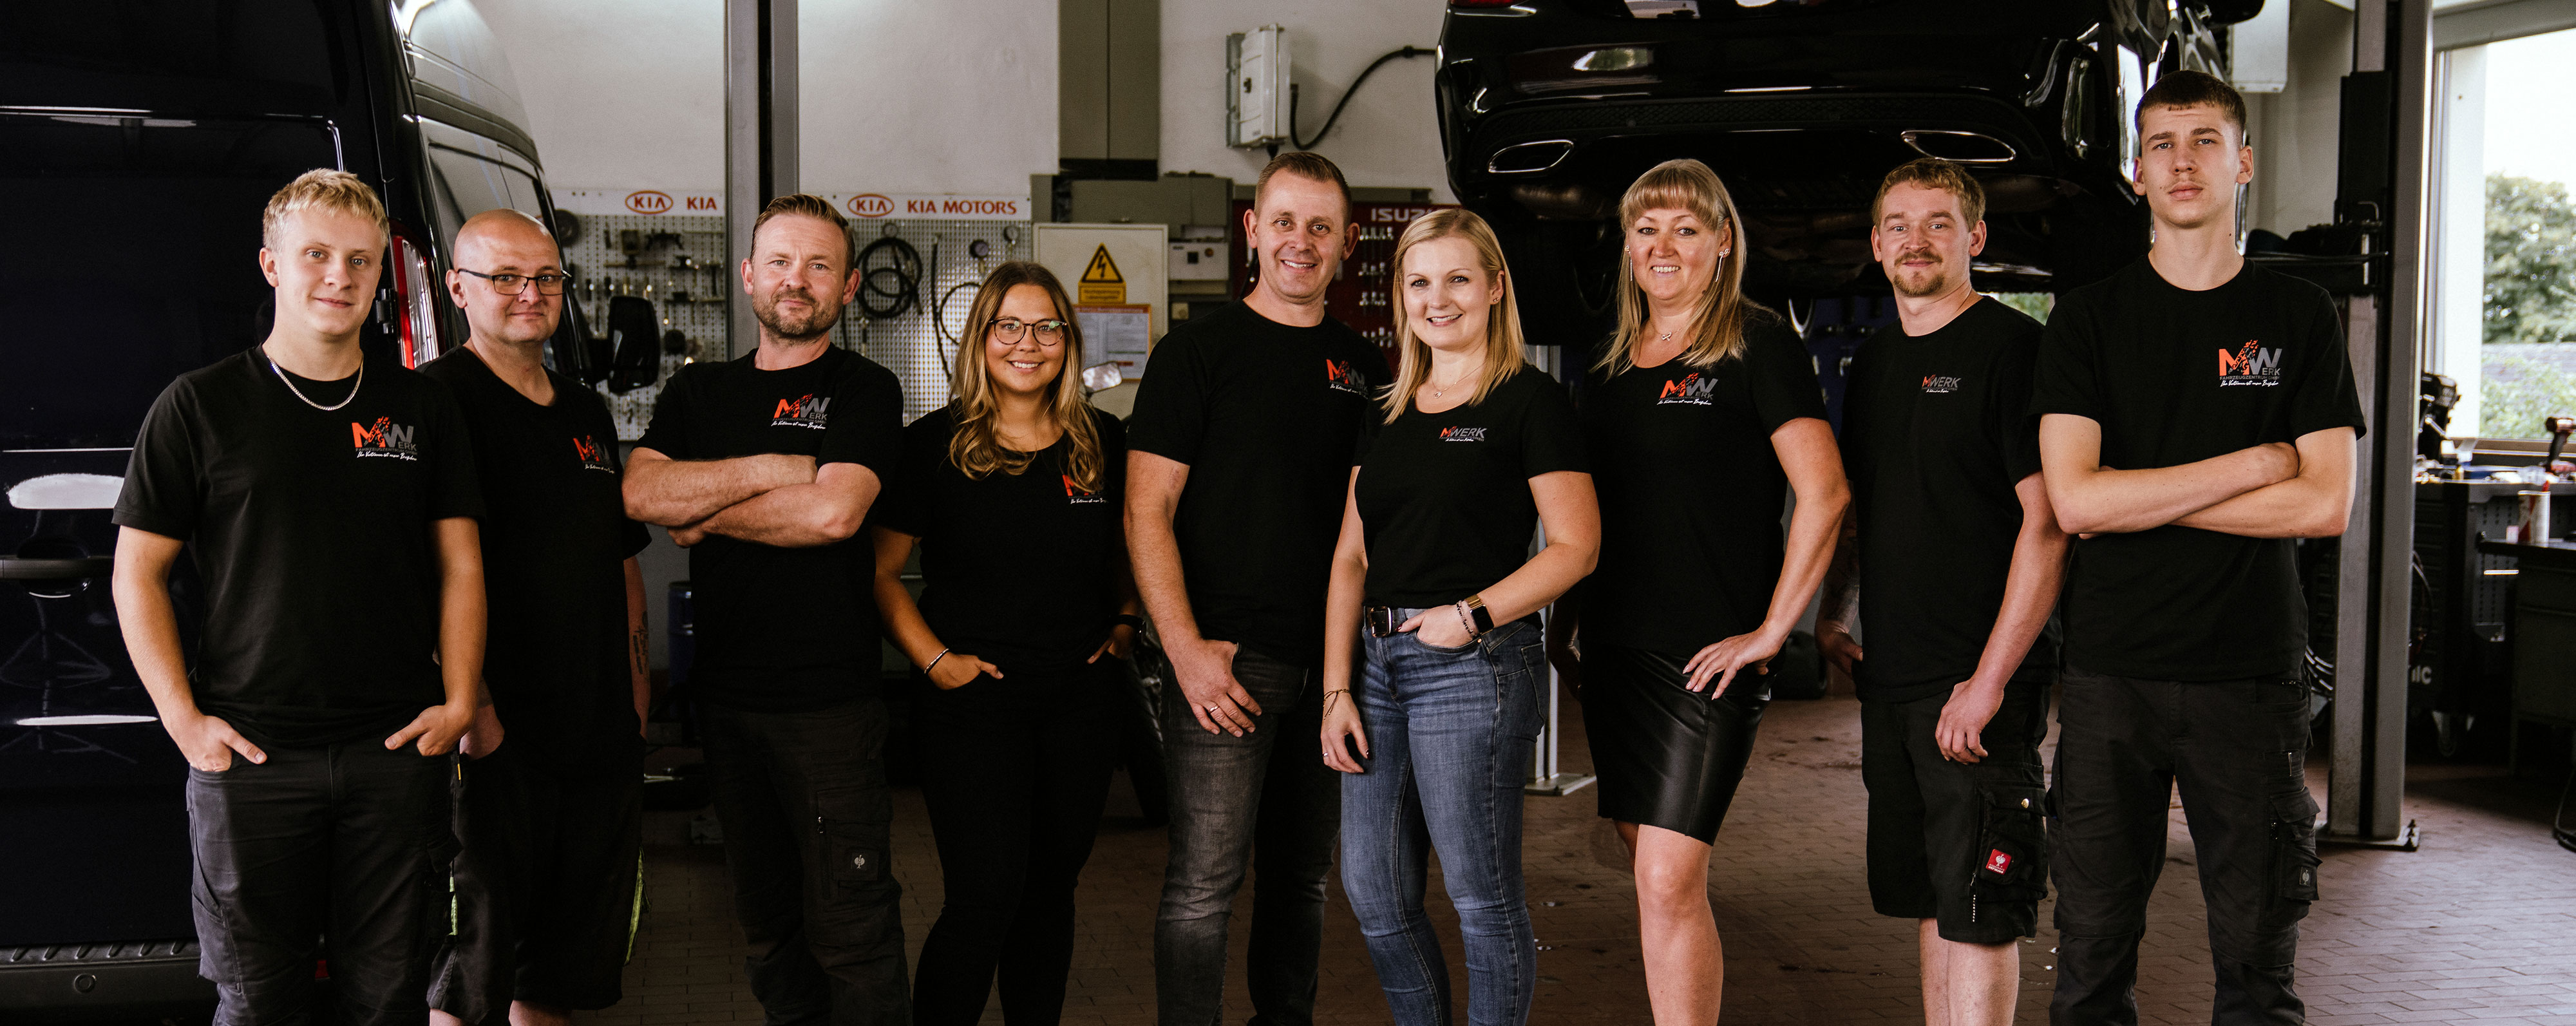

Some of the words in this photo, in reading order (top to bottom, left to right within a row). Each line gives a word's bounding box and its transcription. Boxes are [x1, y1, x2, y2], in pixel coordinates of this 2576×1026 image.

[634, 196, 666, 208] KIA
[687, 196, 717, 210] KIA
[857, 200, 887, 211] KIA
[907, 200, 936, 213] KIA
[943, 200, 1017, 214] MOTORS
[1371, 208, 1432, 222] ISUZ
[1440, 426, 1487, 438] MWERK
